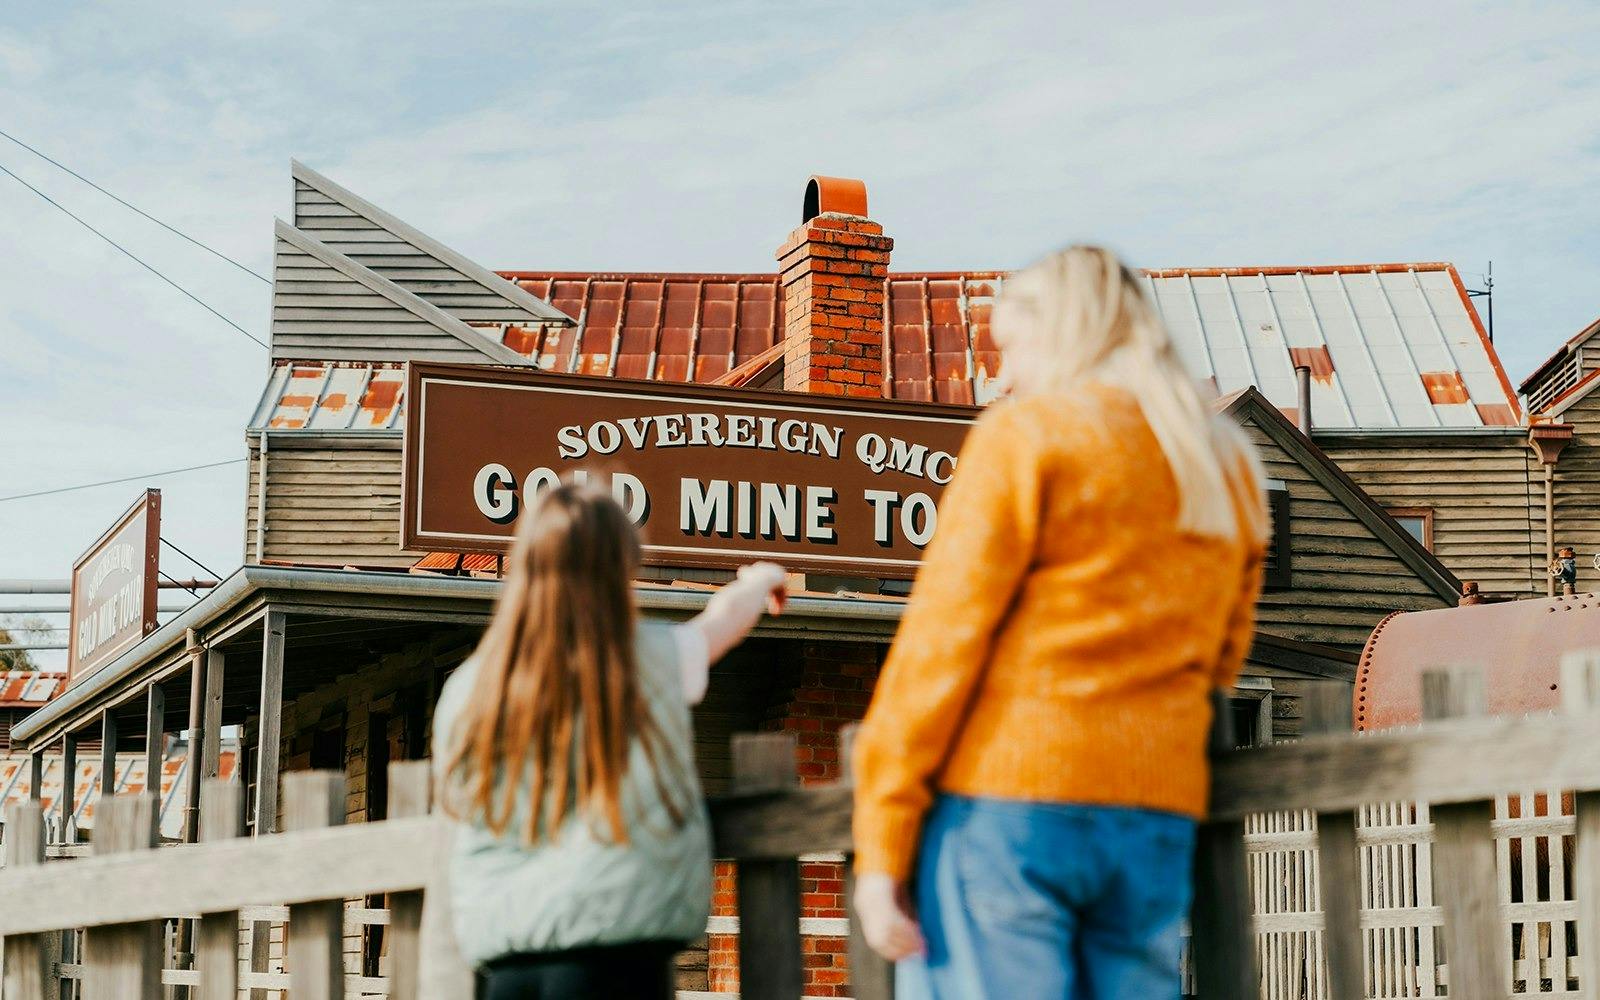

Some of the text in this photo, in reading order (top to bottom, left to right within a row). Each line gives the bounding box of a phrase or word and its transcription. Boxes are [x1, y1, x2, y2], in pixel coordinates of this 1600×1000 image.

[557, 412, 958, 485] SOVEREIGN QMC
[473, 462, 651, 527] GOD
[679, 477, 838, 545] MINE
[78, 574, 141, 660] GOLD MINE TOUR
